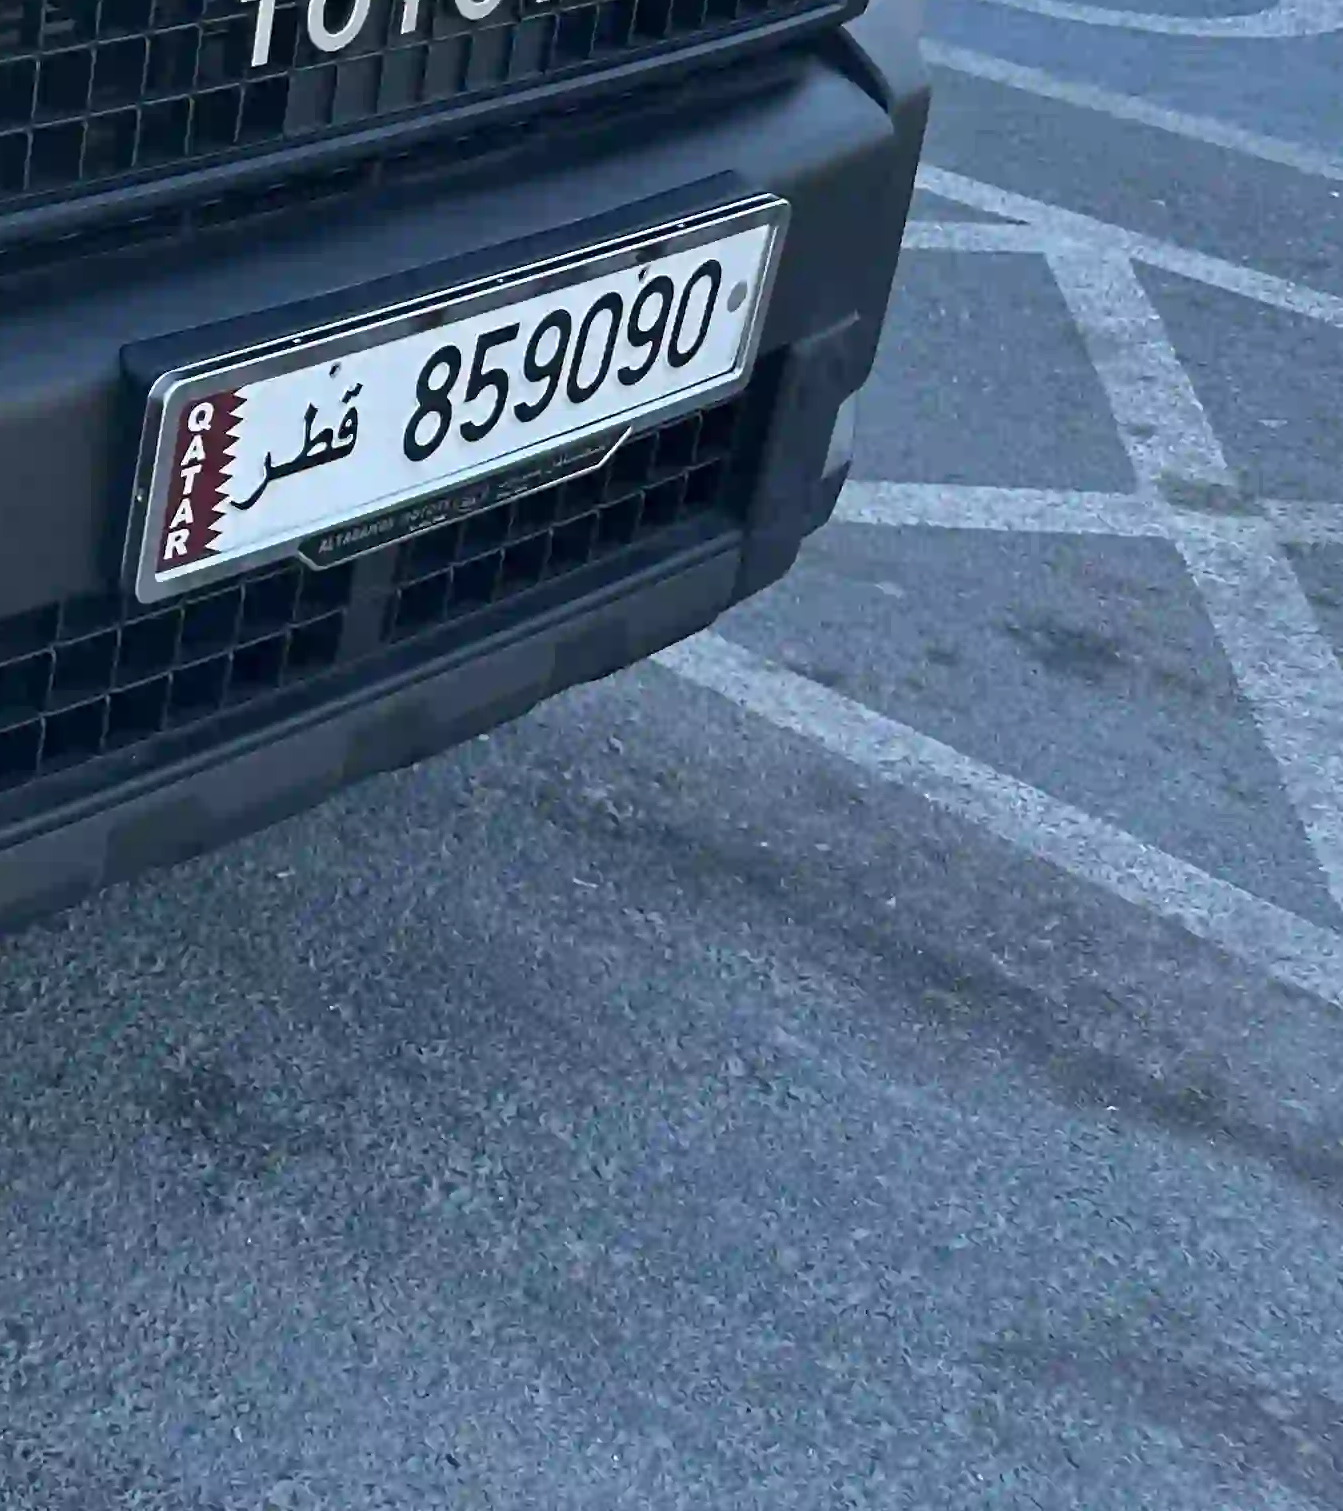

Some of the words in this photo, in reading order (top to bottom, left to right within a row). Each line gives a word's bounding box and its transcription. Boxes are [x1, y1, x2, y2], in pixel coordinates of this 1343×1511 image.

[403, 258, 722, 462] 859090
[163, 401, 214, 561] QATAR
[230, 383, 363, 511] قطر
